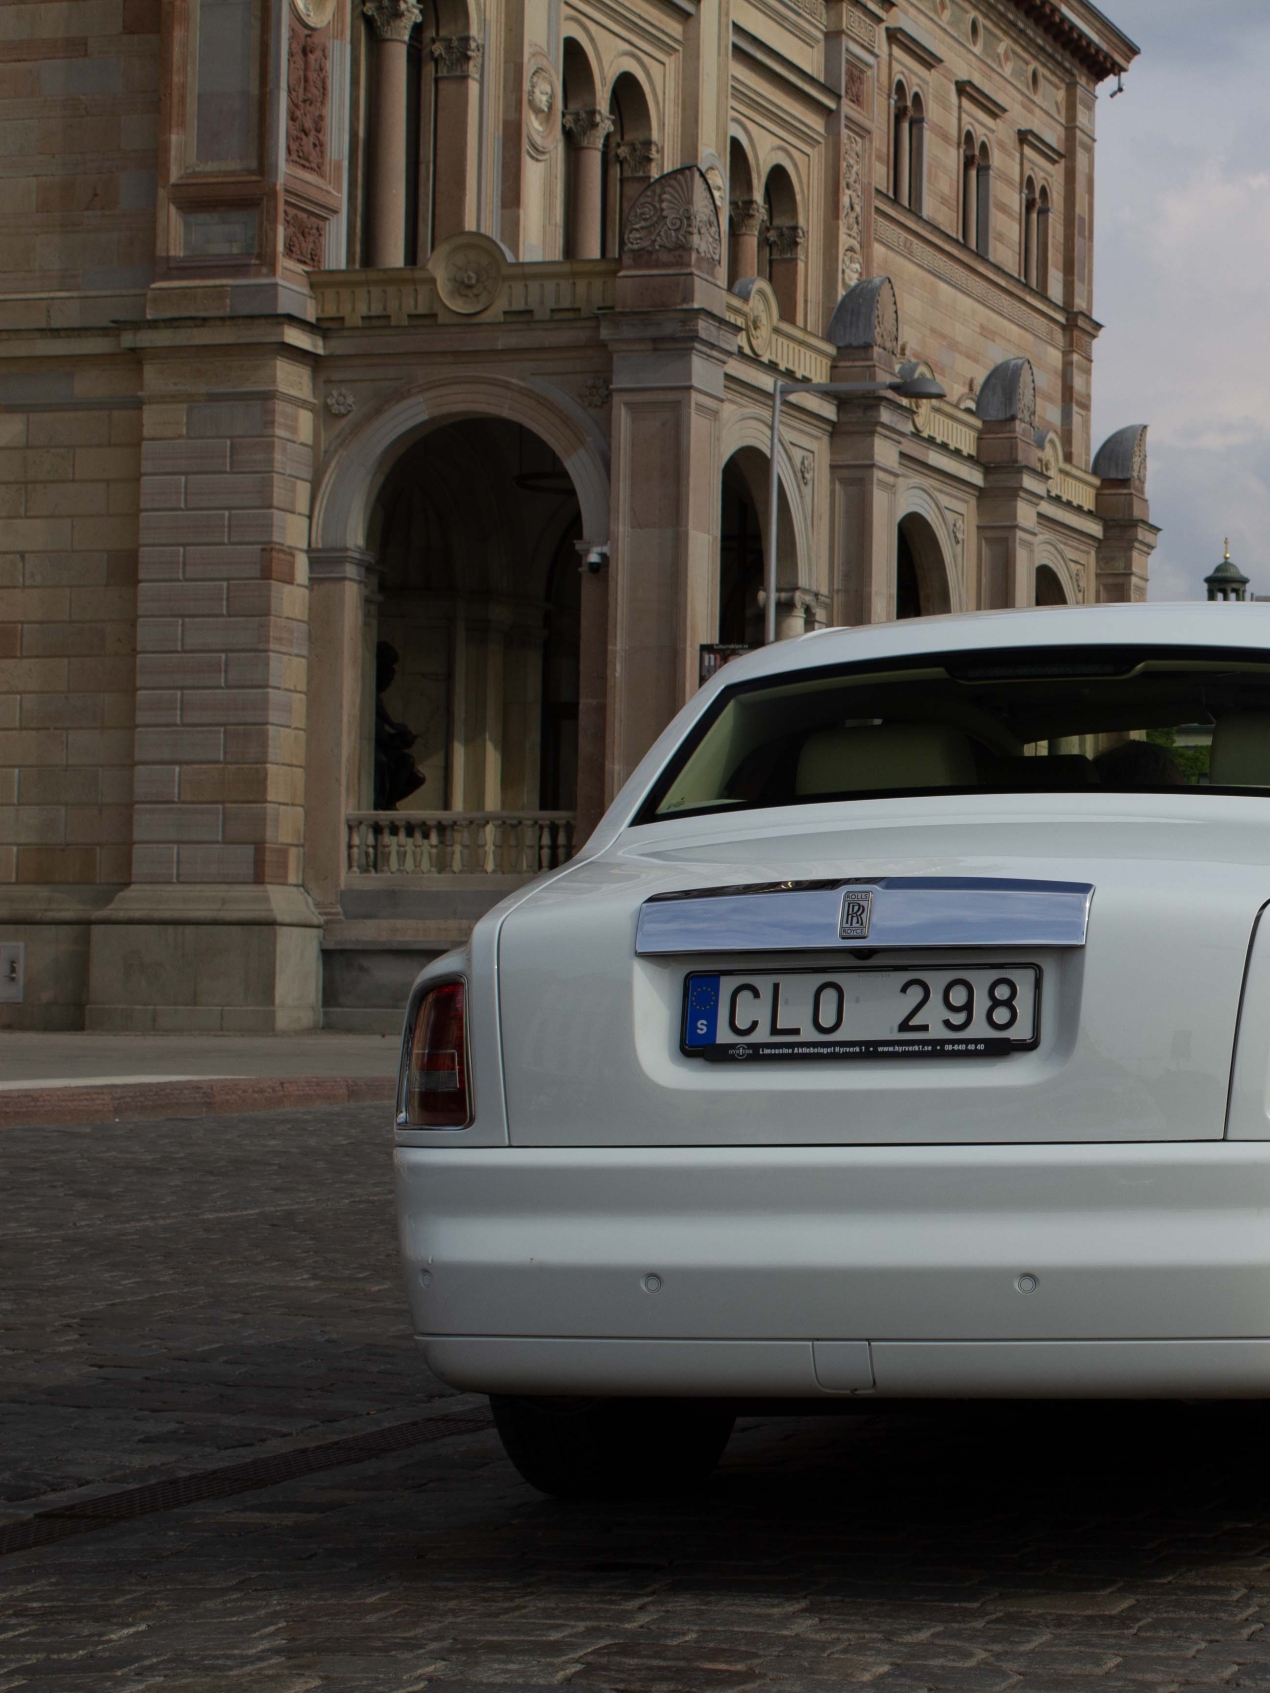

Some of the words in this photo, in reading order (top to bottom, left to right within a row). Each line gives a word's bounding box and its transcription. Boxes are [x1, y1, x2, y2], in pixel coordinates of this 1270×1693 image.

[845, 901, 866, 926] RR
[728, 981, 845, 1037] CLO
[897, 977, 1019, 1033] 298
[696, 1019, 707, 1034] S
[793, 1047, 834, 1055] Aktiebolaget
[835, 1046, 860, 1054] Hyrverk
[877, 1044, 932, 1053] www.hyrverk1.se
